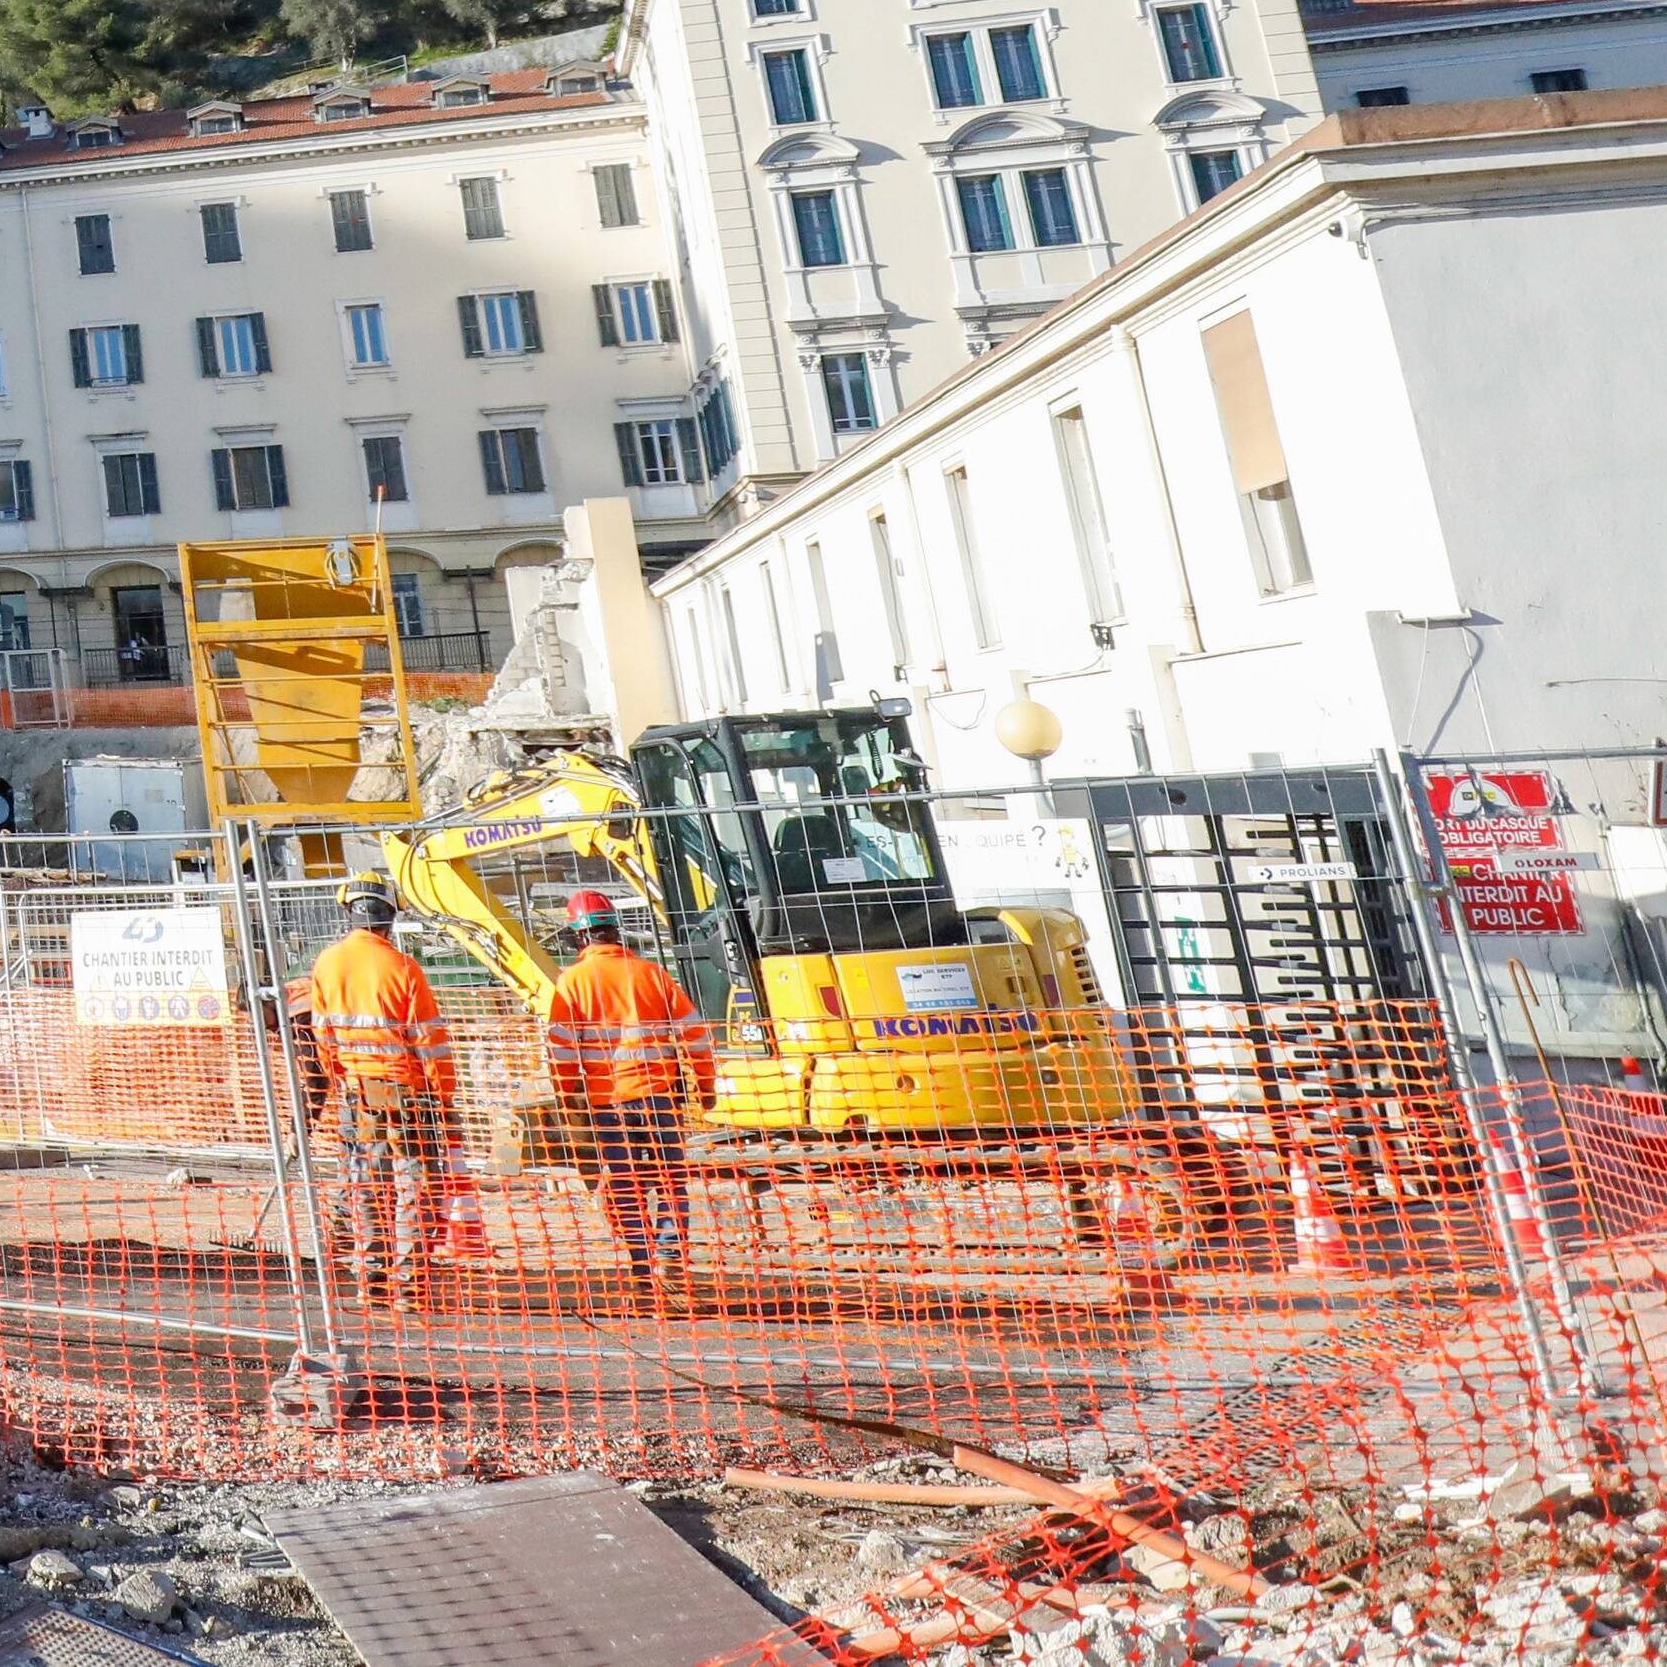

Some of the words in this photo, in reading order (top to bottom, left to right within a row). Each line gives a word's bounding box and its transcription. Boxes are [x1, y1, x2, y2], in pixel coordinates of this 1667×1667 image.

[464, 817, 542, 848] KOMATSU
[1435, 818, 1463, 831] ORT
[1466, 819, 1487, 830] DU
[1489, 817, 1549, 831] CASQUE
[1032, 825, 1046, 847] ?
[1439, 831, 1542, 844] OBLIGATOIRE
[1528, 856, 1577, 869] LOXAM
[1279, 866, 1346, 878] PROLIANS
[1458, 885, 1528, 903] NTERDIT
[1535, 885, 1563, 903] AU
[1471, 908, 1544, 926] PUBLIC
[82, 951, 149, 968] CHANTIER
[151, 949, 213, 966] INTERDIT
[114, 971, 132, 986] AU
[136, 970, 184, 986] PUBLIC
[873, 1005, 1037, 1040] KOMATSU
